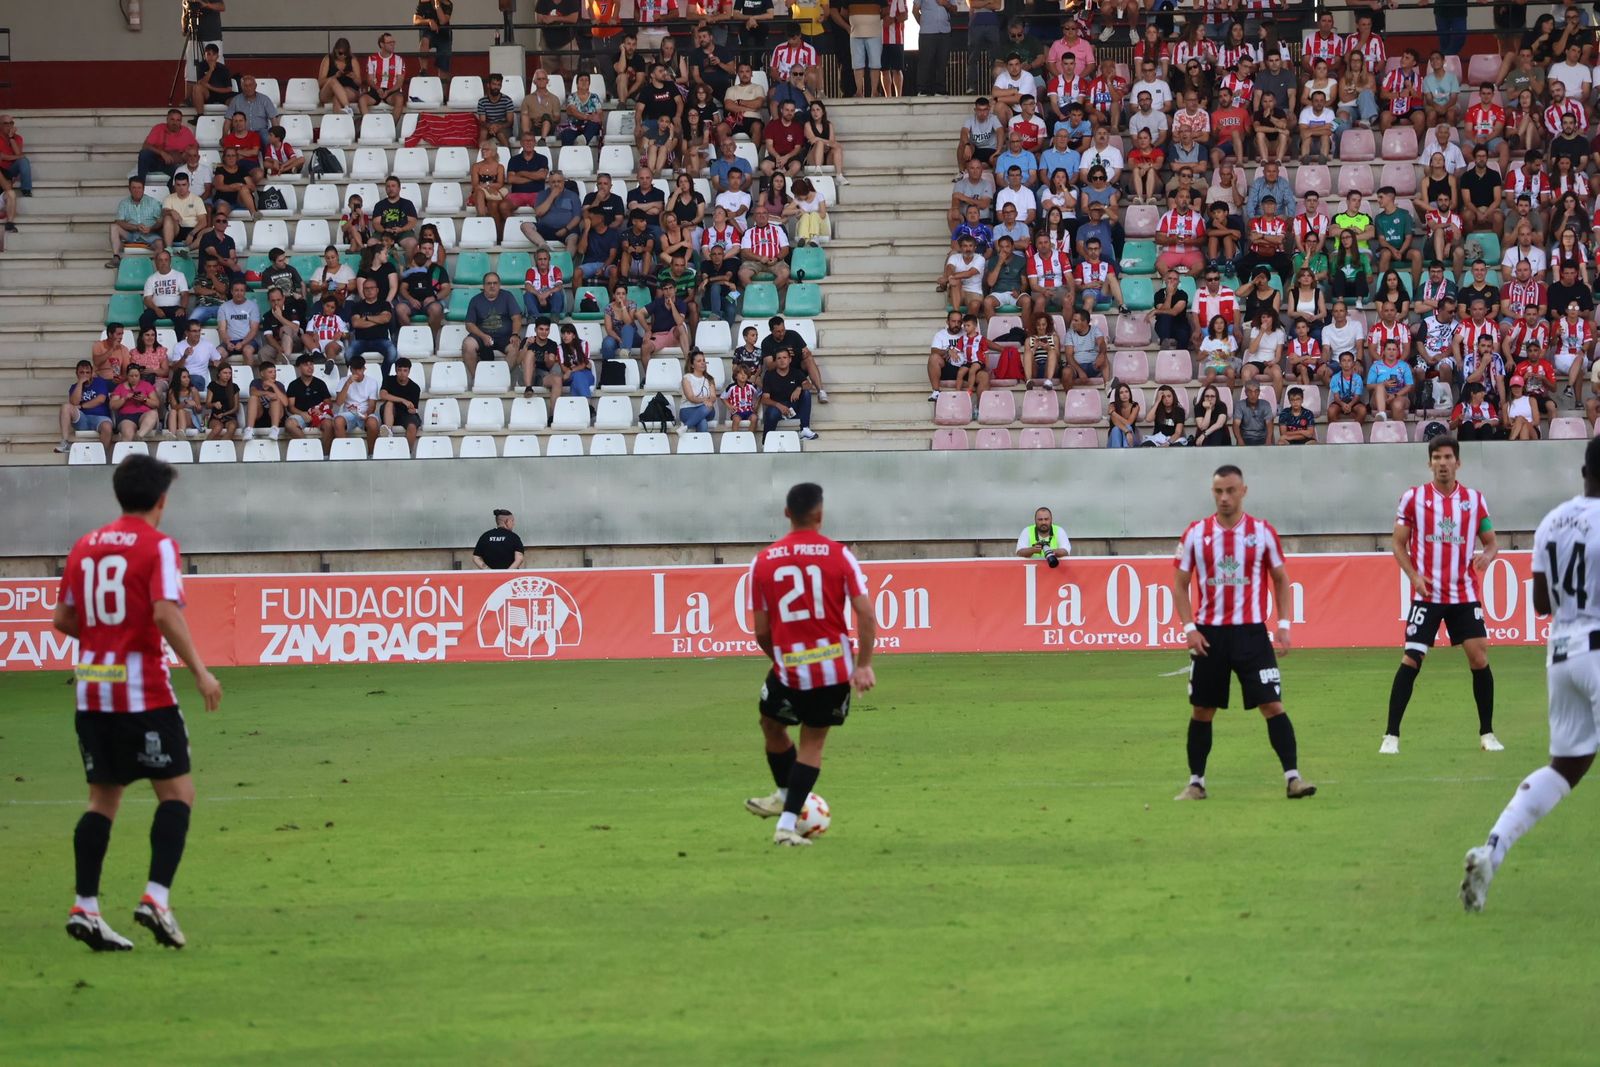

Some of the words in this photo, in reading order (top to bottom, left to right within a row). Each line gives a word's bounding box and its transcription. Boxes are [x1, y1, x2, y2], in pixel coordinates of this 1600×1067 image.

[154, 279, 177, 288] SINCE
[766, 546, 791, 560] JOEL
[794, 544, 830, 556] PRIEGO
[81, 555, 128, 627] 18
[773, 565, 826, 624] 21
[1024, 563, 1086, 627] La
[1546, 541, 1588, 611] 14
[261, 577, 465, 621] FUNDACIÓN
[651, 572, 715, 635] La
[1410, 605, 1427, 625] 16
[672, 637, 692, 653] El
[1043, 629, 1065, 645] El
[1069, 629, 1142, 645] Correo
[1162, 627, 1188, 644] de
